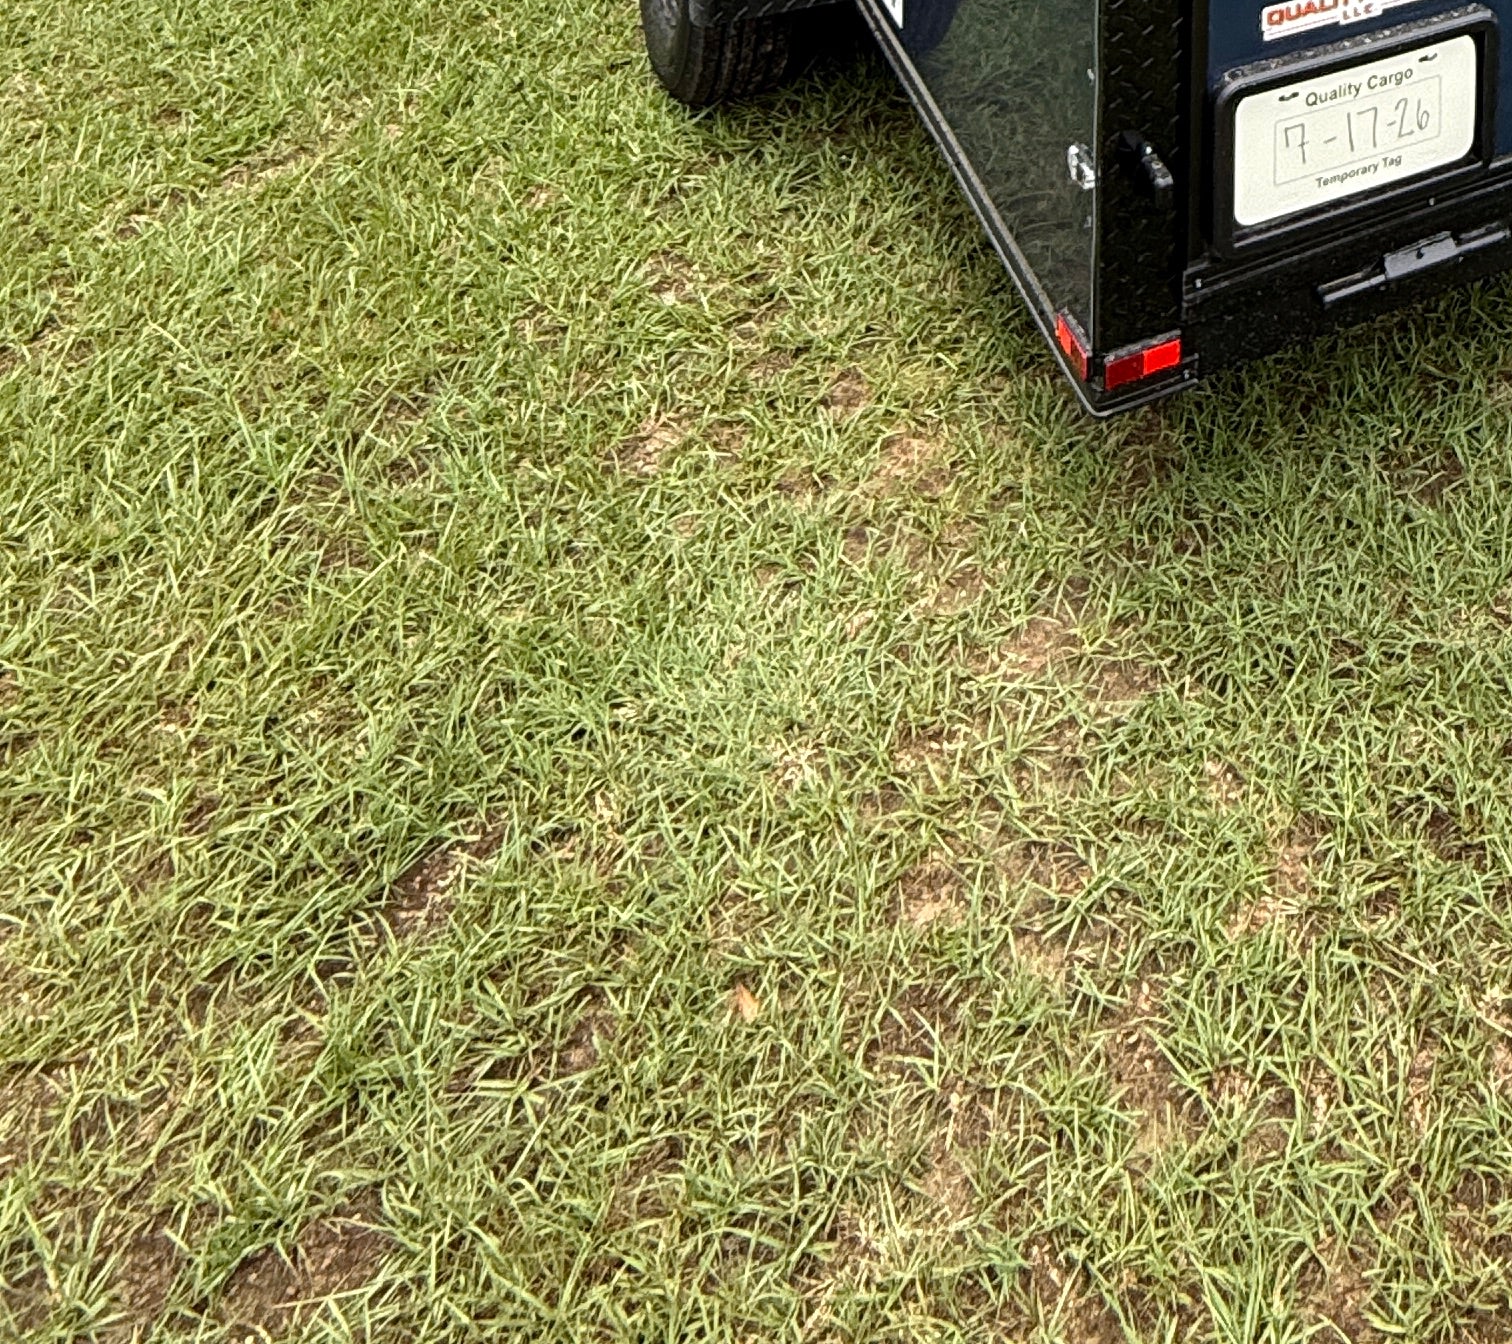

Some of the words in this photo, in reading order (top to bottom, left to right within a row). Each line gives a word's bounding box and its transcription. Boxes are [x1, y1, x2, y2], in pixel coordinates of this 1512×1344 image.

[1305, 82, 1363, 107] Quality
[1367, 68, 1413, 90] Cargo
[1315, 161, 1380, 188] Temporary
[1382, 155, 1403, 168] Tag
